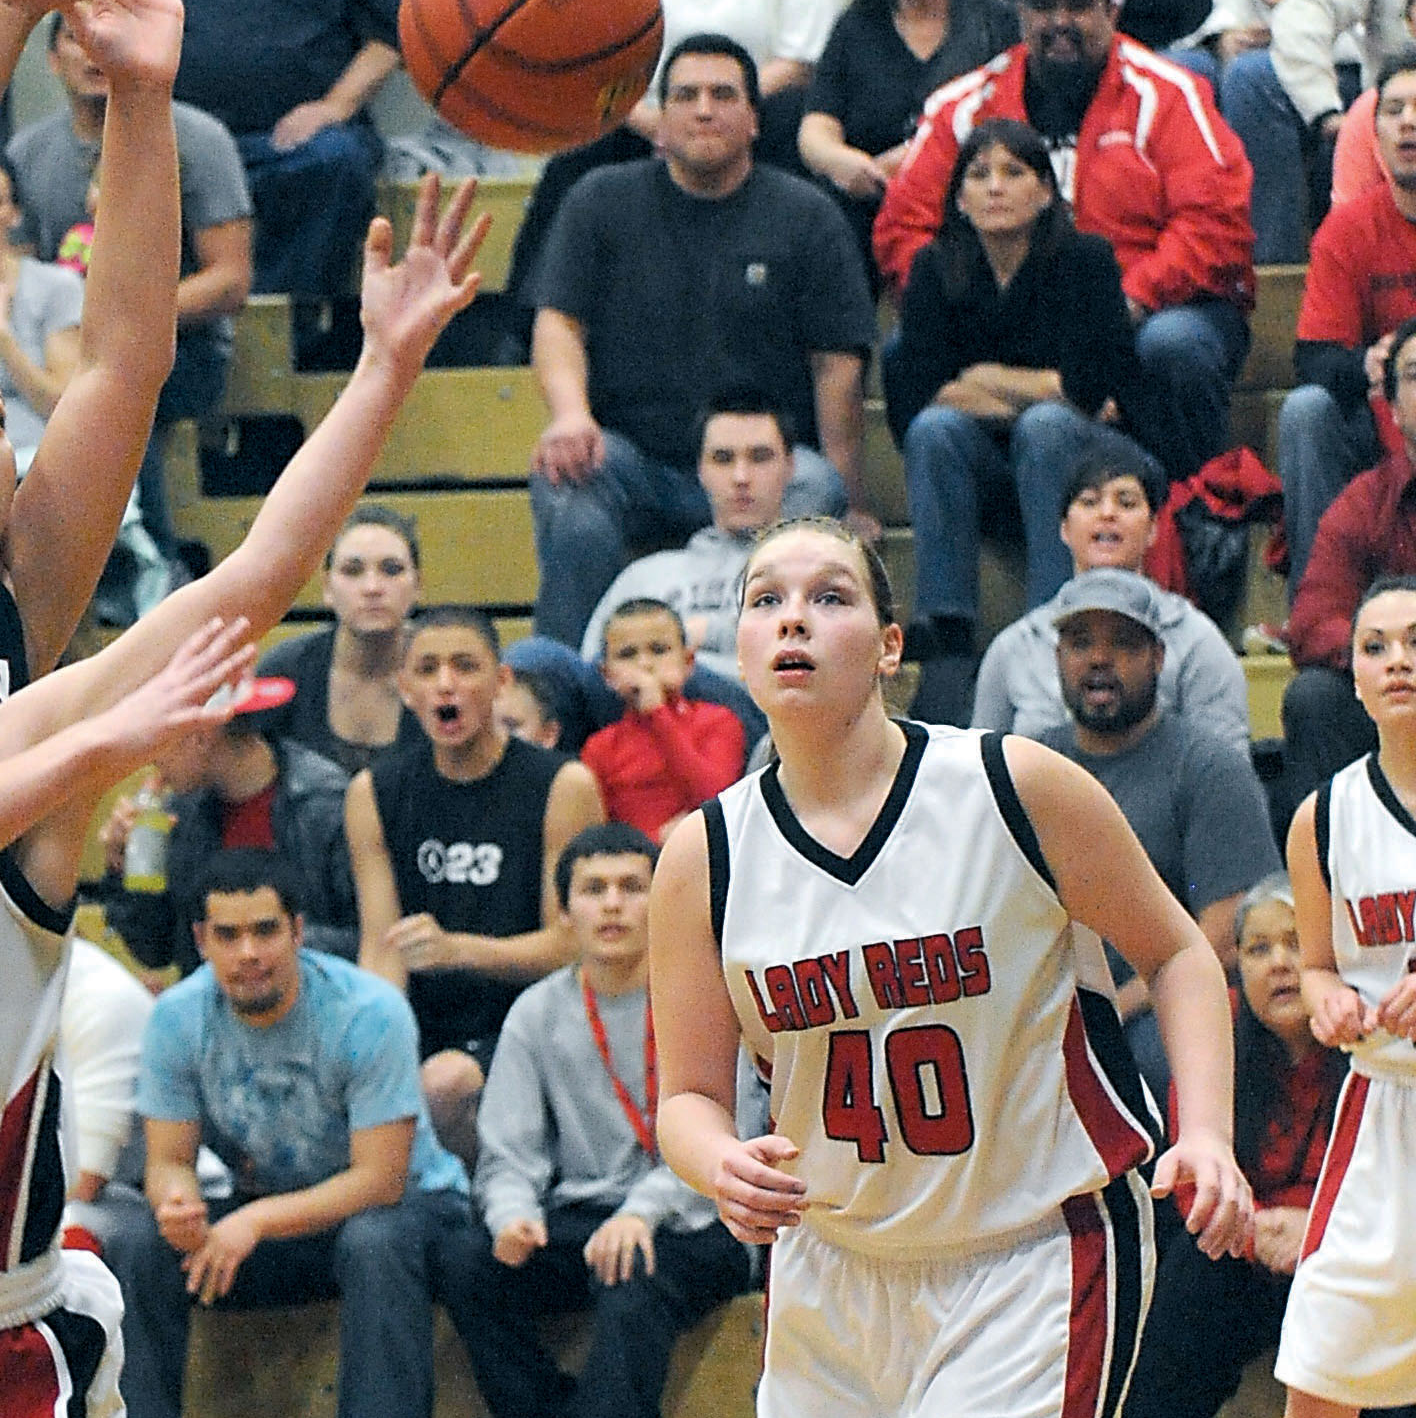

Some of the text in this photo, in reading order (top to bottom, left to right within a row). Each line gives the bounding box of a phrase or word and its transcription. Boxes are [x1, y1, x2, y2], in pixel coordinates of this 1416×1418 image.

[1344, 888, 1416, 948] LADY
[744, 925, 992, 1034] LADY REDS
[821, 1022, 976, 1164] 40
